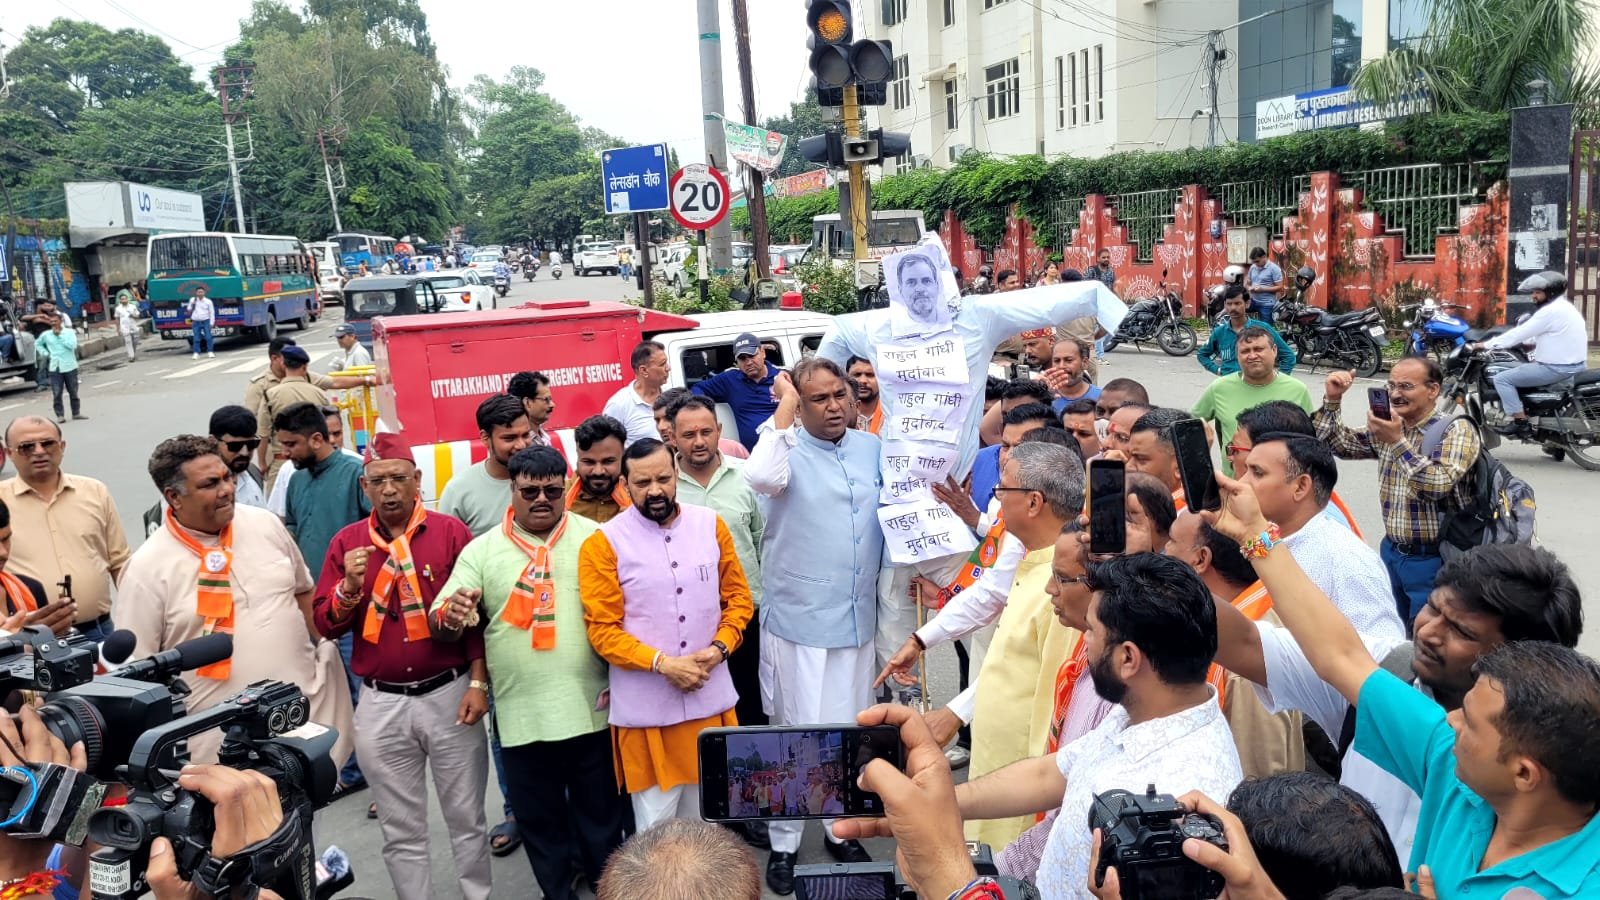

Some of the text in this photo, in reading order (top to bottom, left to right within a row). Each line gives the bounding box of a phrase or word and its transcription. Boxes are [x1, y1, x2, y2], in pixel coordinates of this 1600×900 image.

[1272, 112, 1293, 122] LIBRARY
[1315, 110, 1347, 129] LIBRARY
[643, 168, 660, 188] चौक
[680, 181, 720, 212] 20
[157, 309, 177, 318] BLOW
[218, 307, 239, 316] HORN
[882, 340, 955, 362] राहुल गांधी
[431, 375, 502, 399] UTTARAKHAND
[540, 366, 584, 387] ERGENCY
[585, 363, 622, 381] SERVICE
[898, 391, 962, 408] राहुल गांधी
[901, 413, 946, 434] मुर्दाबाद
[886, 455, 947, 473] राहुल गांधी
[885, 511, 919, 531] राहुल
[905, 532, 953, 557] मुर्दाबाद
